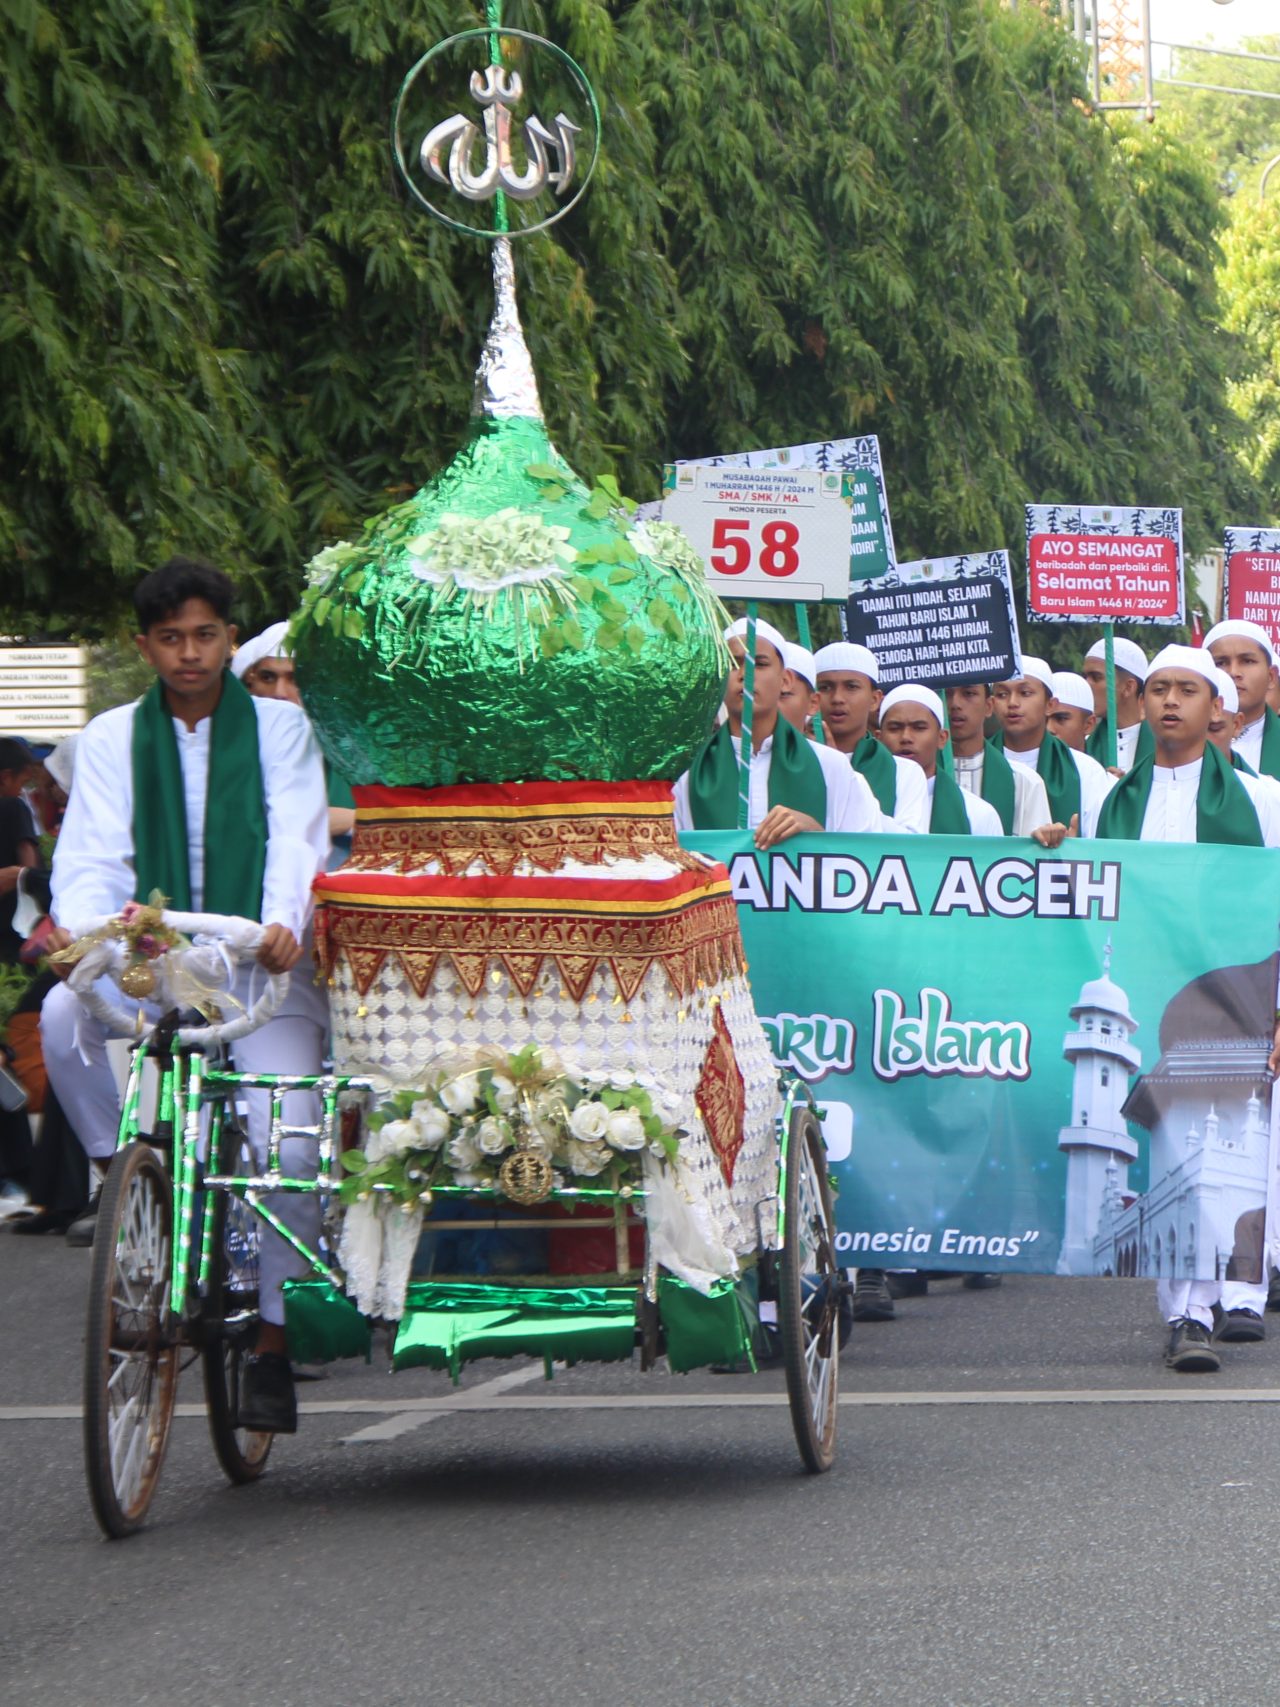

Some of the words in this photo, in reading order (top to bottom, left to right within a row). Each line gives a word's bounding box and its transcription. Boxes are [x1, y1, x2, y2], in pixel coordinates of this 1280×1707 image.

[710, 482, 754, 490] MUHARRAM
[788, 485, 806, 493] 2024
[723, 474, 771, 483] MUSABAQAH
[773, 475, 797, 483] PAWAI
[718, 491, 740, 500] SMA
[751, 492, 772, 501] SMK
[783, 494, 799, 503] MA
[851, 520, 877, 535] DAAN
[710, 518, 800, 577] 58
[1041, 541, 1074, 555] AYO
[1078, 542, 1164, 558] SEMANGAT
[1036, 560, 1086, 570] beribadah
[1088, 561, 1107, 571] dan
[1109, 562, 1149, 573] perbaiki
[1151, 563, 1170, 572] diri.
[1038, 572, 1112, 590] Selamat
[1115, 575, 1170, 592] Tahun
[857, 598, 894, 613] “DAMAI
[896, 594, 912, 609] ITU
[913, 589, 946, 607] INDAH.
[947, 584, 992, 602] SELAMAT
[1040, 596, 1065, 606] Baru
[1067, 597, 1095, 607] Islam
[1098, 598, 1122, 608] 1446
[876, 612, 909, 629] TAHUN
[910, 609, 937, 625] BARU
[938, 605, 969, 622] ISLAM
[971, 604, 978, 618] 1
[1243, 607, 1268, 621] DARI
[865, 629, 923, 648] MUHARRAM
[925, 626, 950, 641] 1446
[952, 620, 993, 638] HIJRIAH.
[875, 650, 914, 665] SEMOGA
[915, 643, 966, 660] HARI-HARI
[967, 639, 990, 654] KITA
[877, 667, 904, 684] NUHI
[905, 662, 945, 680] DENGAN
[946, 655, 1009, 675] KEDAMAIAN”
[729, 852, 922, 915] ANDA
[930, 856, 1122, 921] ACEH
[759, 1014, 855, 1080] aru
[872, 988, 1030, 1079] Islam
[833, 1227, 932, 1252] onesia
[939, 1229, 1040, 1257] Emas”
